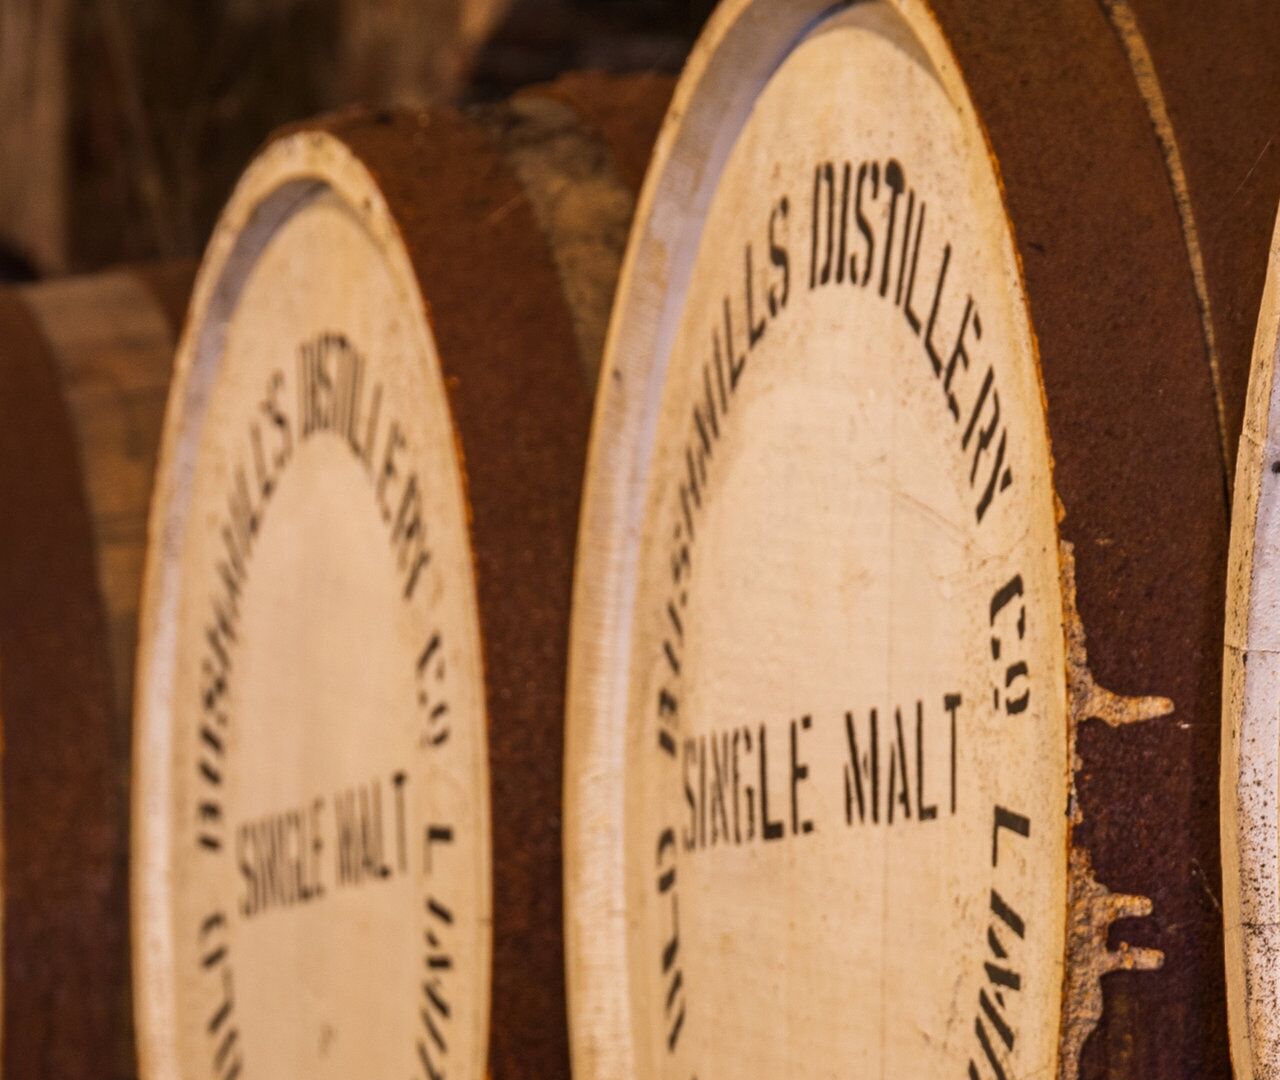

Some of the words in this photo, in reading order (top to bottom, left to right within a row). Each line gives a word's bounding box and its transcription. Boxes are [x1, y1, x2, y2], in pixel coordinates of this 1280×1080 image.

[809, 158, 1013, 525] DISTILLERY
[681, 714, 815, 852] SINGLE
[844, 693, 962, 827] MALT
